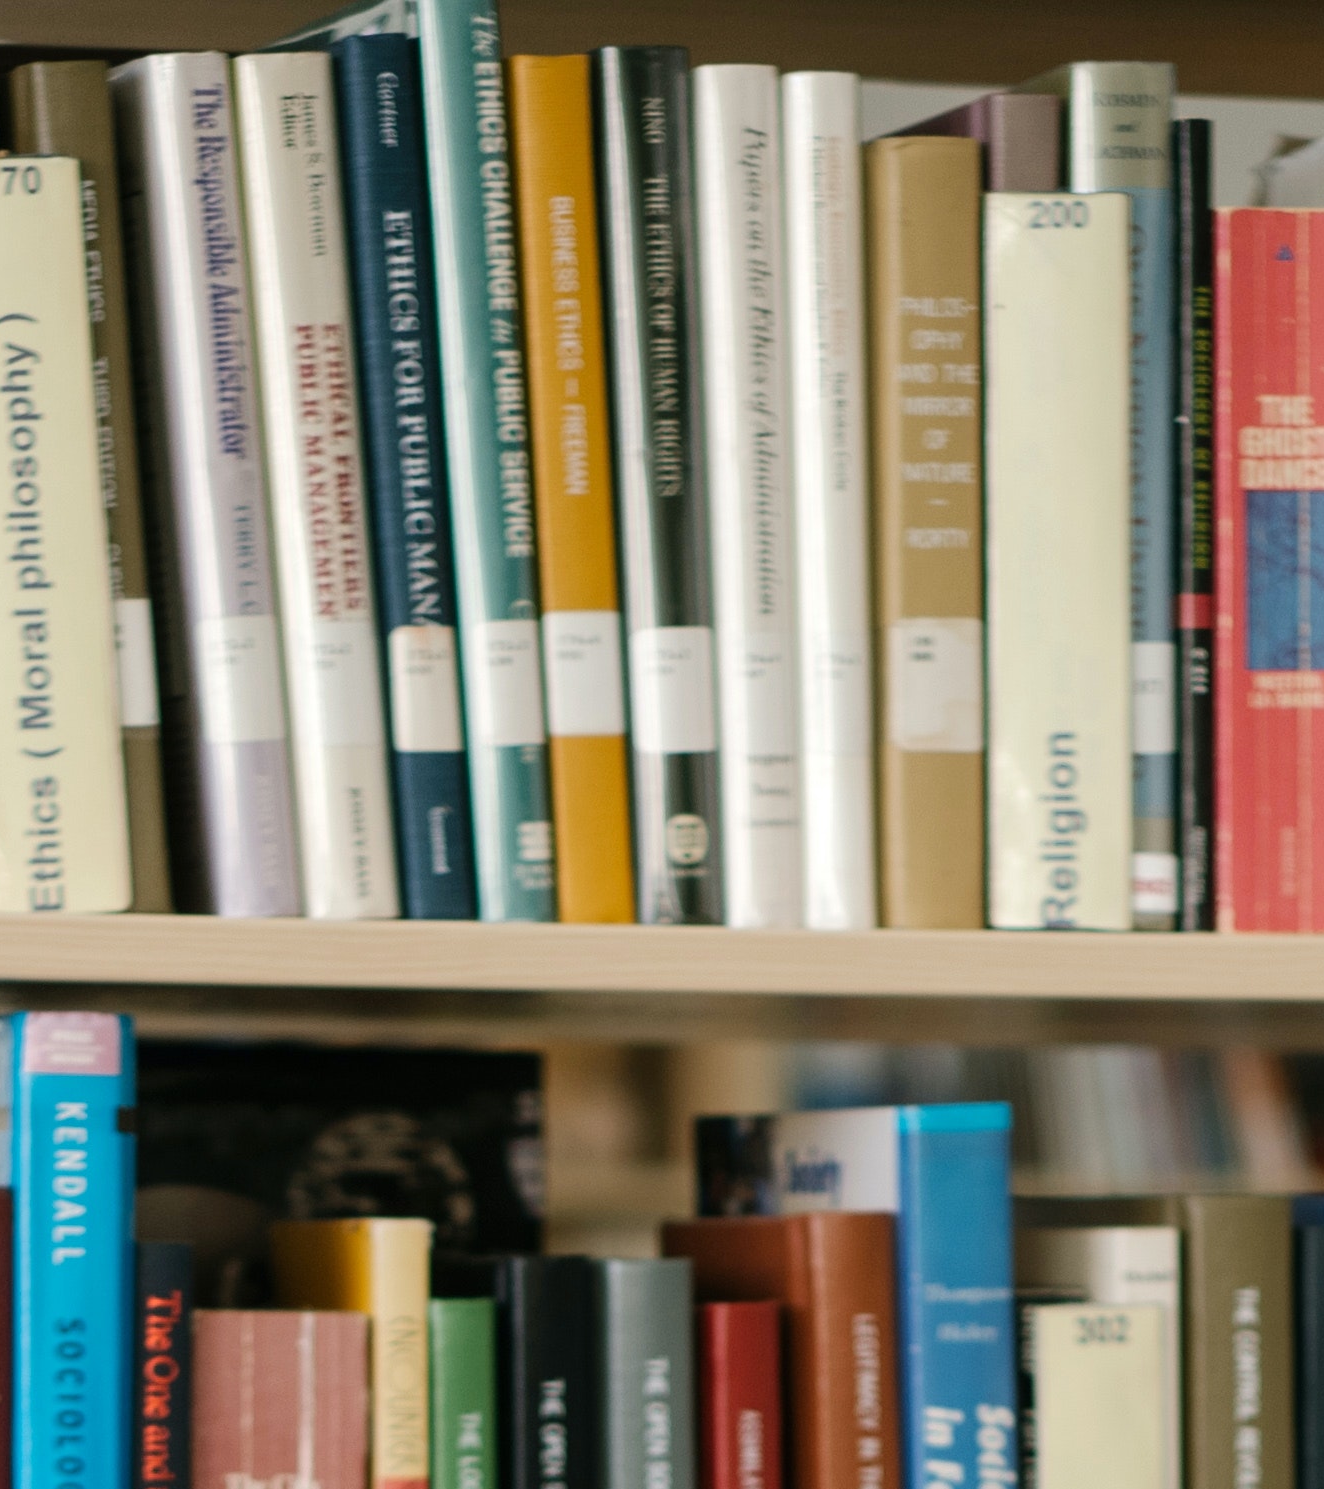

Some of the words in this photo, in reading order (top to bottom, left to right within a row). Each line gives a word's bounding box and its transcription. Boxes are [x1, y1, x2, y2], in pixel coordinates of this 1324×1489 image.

[191, 84, 225, 130] The
[474, 61, 509, 153] ETHICS
[193, 135, 238, 277] Responsible
[481, 160, 520, 312] CHALLENGE
[548, 195, 580, 292] BUSINESS
[1028, 201, 1089, 229] 200
[381, 210, 423, 332] ETHICS
[210, 282, 248, 459] Administrator
[293, 323, 323, 424] PUBLIC
[321, 323, 353, 445] ETHICAL
[390, 339, 428, 407] FOR
[554, 299, 586, 371] ETHICS
[492, 350, 527, 444] PUBLIC
[1255, 394, 1315, 425] THE
[396, 413, 436, 534] PUBLIC
[561, 404, 591, 495] FREEMAN
[333, 454, 367, 610] FRONTIERS
[501, 451, 535, 558] SERVICE
[12, 608, 54, 731] Moral
[24, 777, 65, 914] Ethics
[1038, 730, 1089, 928] Religion
[50, 1100, 88, 1267] KENDALL
[144, 1289, 181, 1349] The
[144, 1355, 181, 1418] One
[143, 1425, 179, 1483] and
